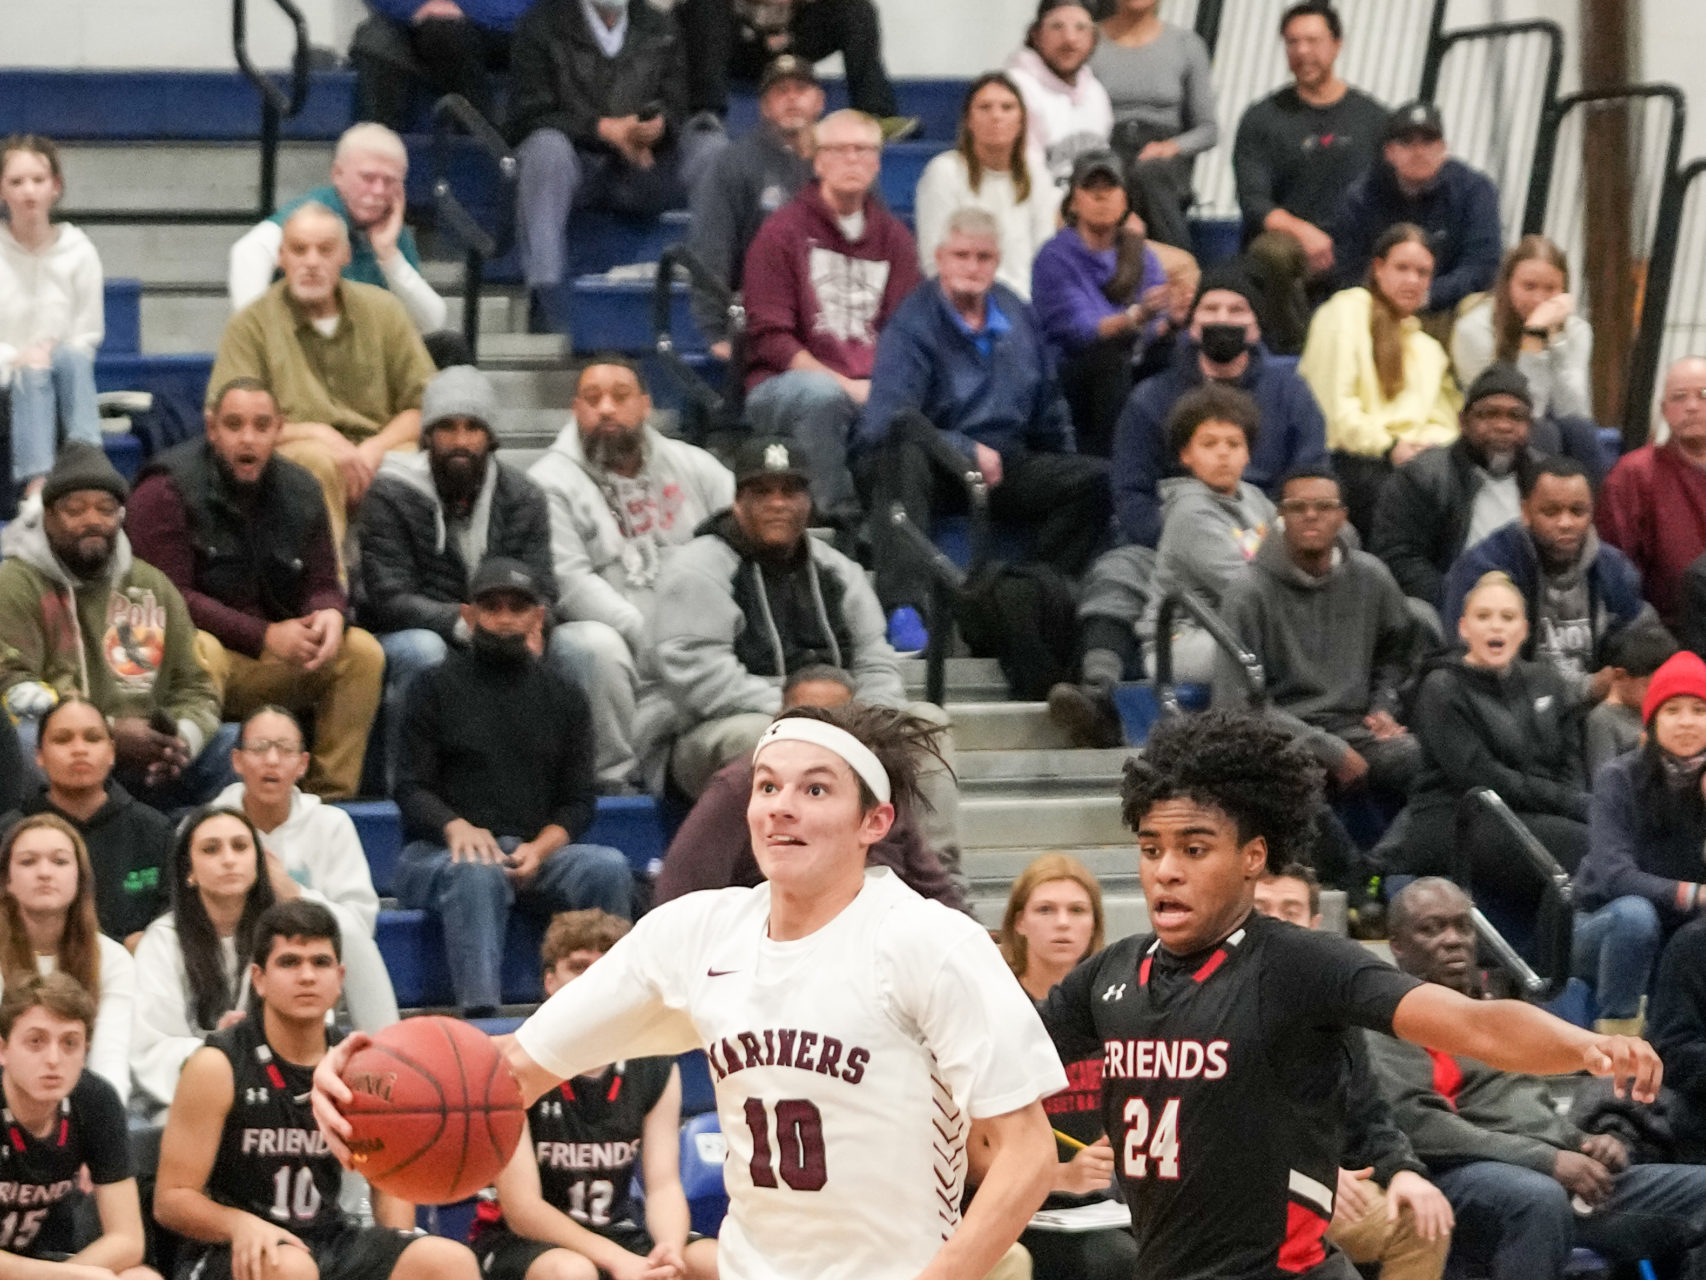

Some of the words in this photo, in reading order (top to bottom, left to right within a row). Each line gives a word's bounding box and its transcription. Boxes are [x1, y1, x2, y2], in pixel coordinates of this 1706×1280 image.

[1101, 1038, 1231, 1080] FRIENDS
[743, 1097, 828, 1191] 10
[1123, 1096, 1181, 1179] 24
[269, 1166, 321, 1219] 10
[568, 1180, 614, 1224] 12
[0, 1207, 48, 1248] 15
